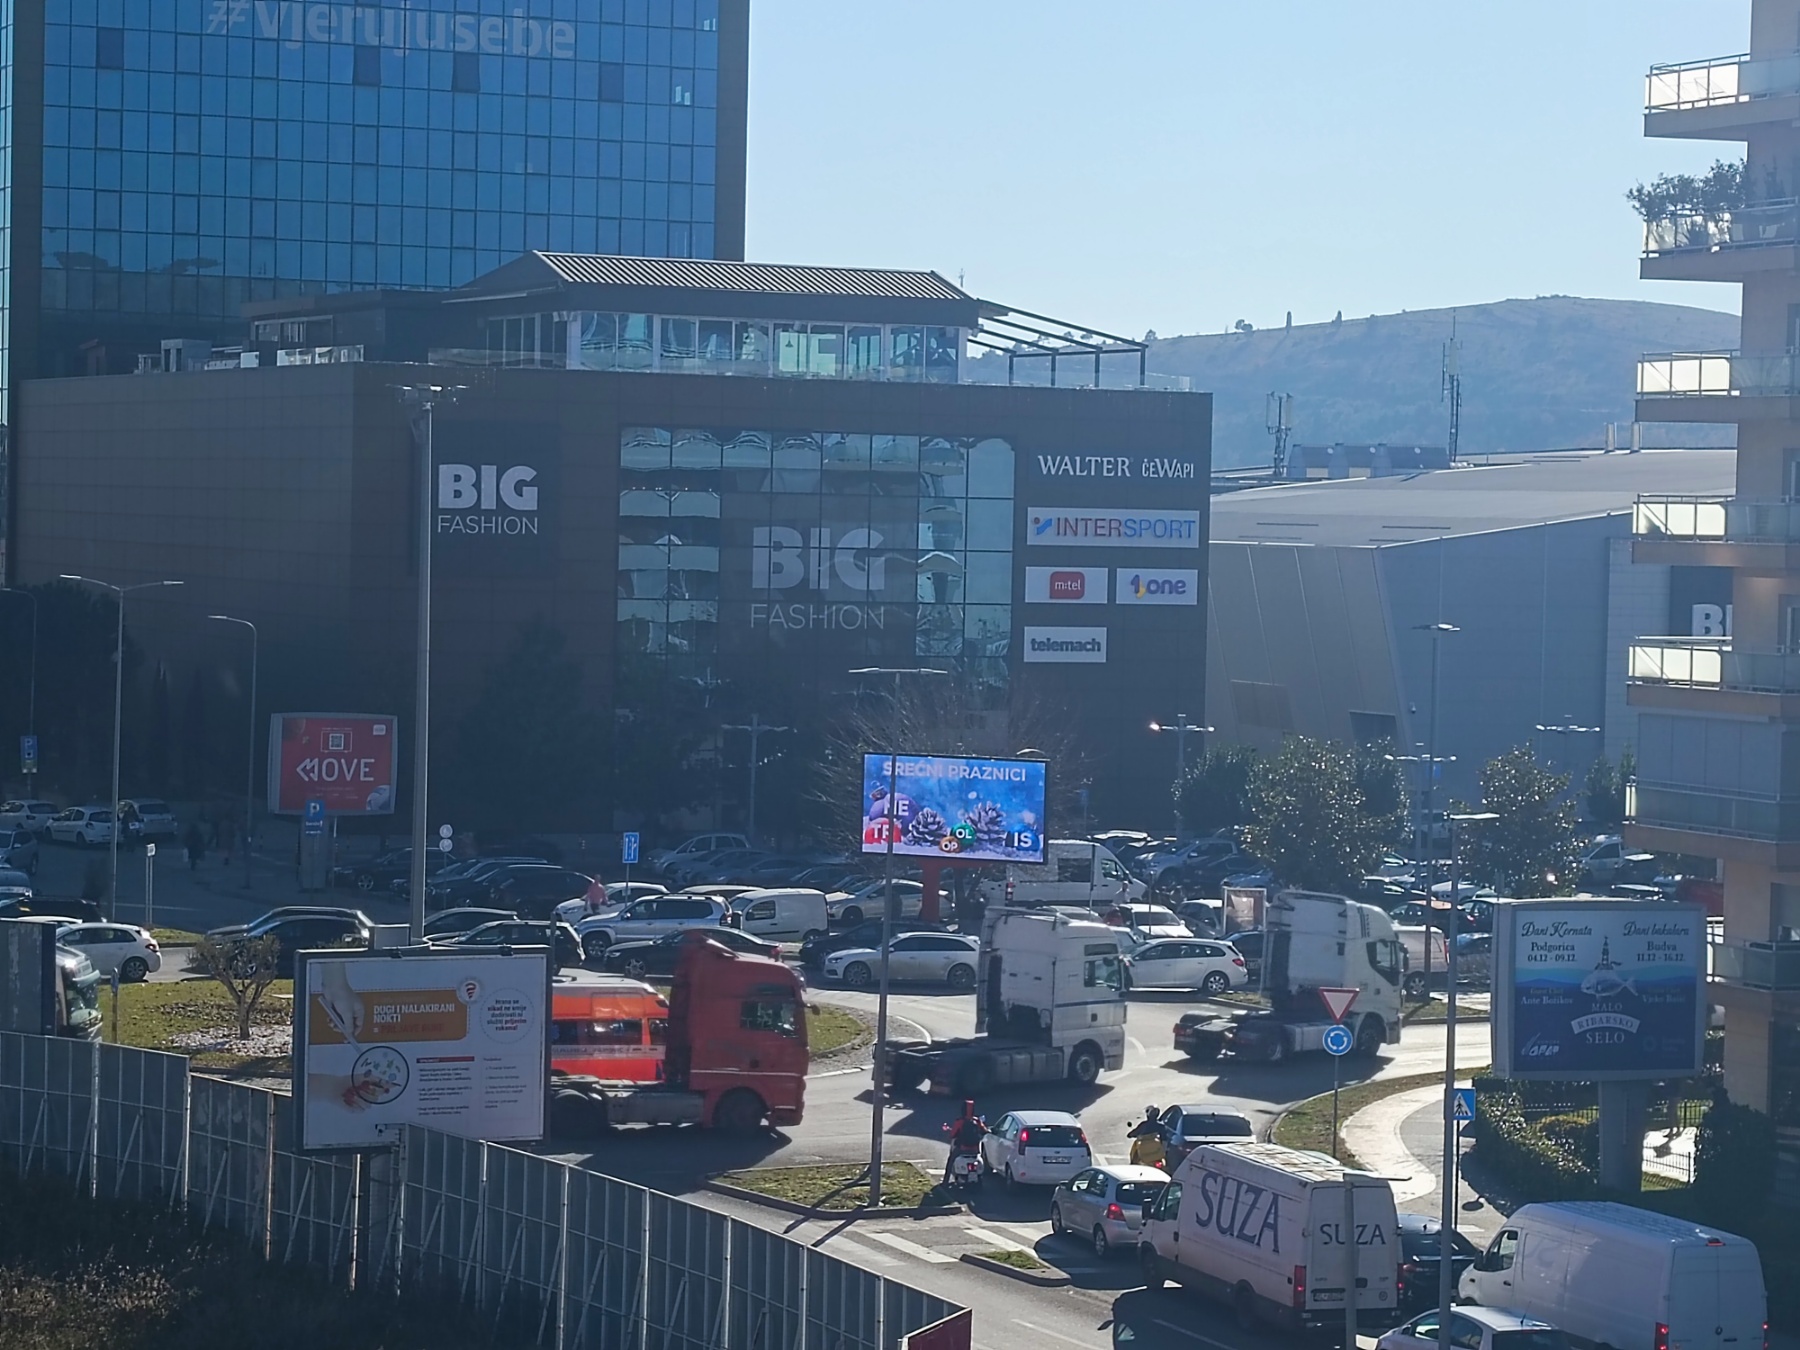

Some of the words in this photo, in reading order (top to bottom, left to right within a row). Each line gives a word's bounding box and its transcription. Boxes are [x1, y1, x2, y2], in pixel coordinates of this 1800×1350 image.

[206, 0, 576, 59] #vjerujusebe
[1037, 455, 1131, 477] WALTER
[438, 464, 538, 510] BIG
[438, 515, 539, 535] FASHION
[1056, 517, 1196, 538] INTERSPORT
[752, 526, 886, 591] BIG
[750, 603, 885, 630] FASHION
[1030, 637, 1102, 653] telemach
[296, 757, 375, 782] MOVE
[948, 766, 1026, 782] PRAZNICI
[955, 828, 972, 839] OL
[1013, 831, 1032, 847] IS
[1521, 922, 1549, 937] Dani
[1623, 921, 1651, 937] Dani
[1531, 942, 1575, 954] Podgorica
[1647, 941, 1677, 952] Budva
[373, 1004, 395, 1014] DUGI
[1591, 1003, 1623, 1012] MALO
[373, 1014, 401, 1023] NOKTI
[1577, 1015, 1634, 1030] RIBARSKO
[1585, 1032, 1625, 1044] SELO
[1195, 1171, 1280, 1255] SUZA
[1320, 1223, 1386, 1245] SUZA
